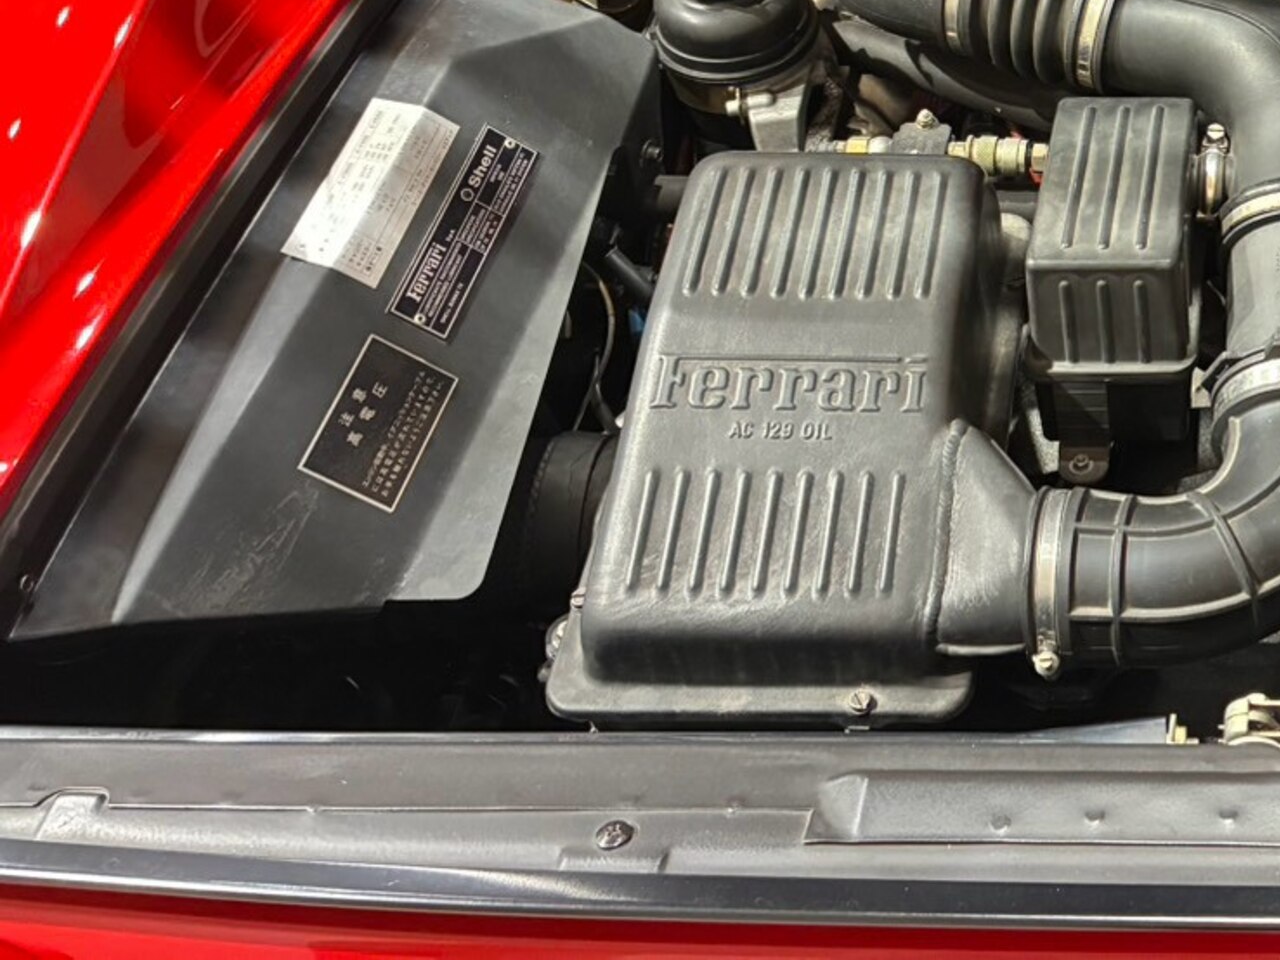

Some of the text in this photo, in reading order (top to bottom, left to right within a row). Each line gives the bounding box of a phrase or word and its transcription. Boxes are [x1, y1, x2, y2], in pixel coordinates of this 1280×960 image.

[468, 144, 498, 188] Shell
[404, 240, 447, 303] Ferrari
[650, 354, 928, 412] Ferrari
[729, 421, 754, 439] AC
[763, 421, 795, 440] 129
